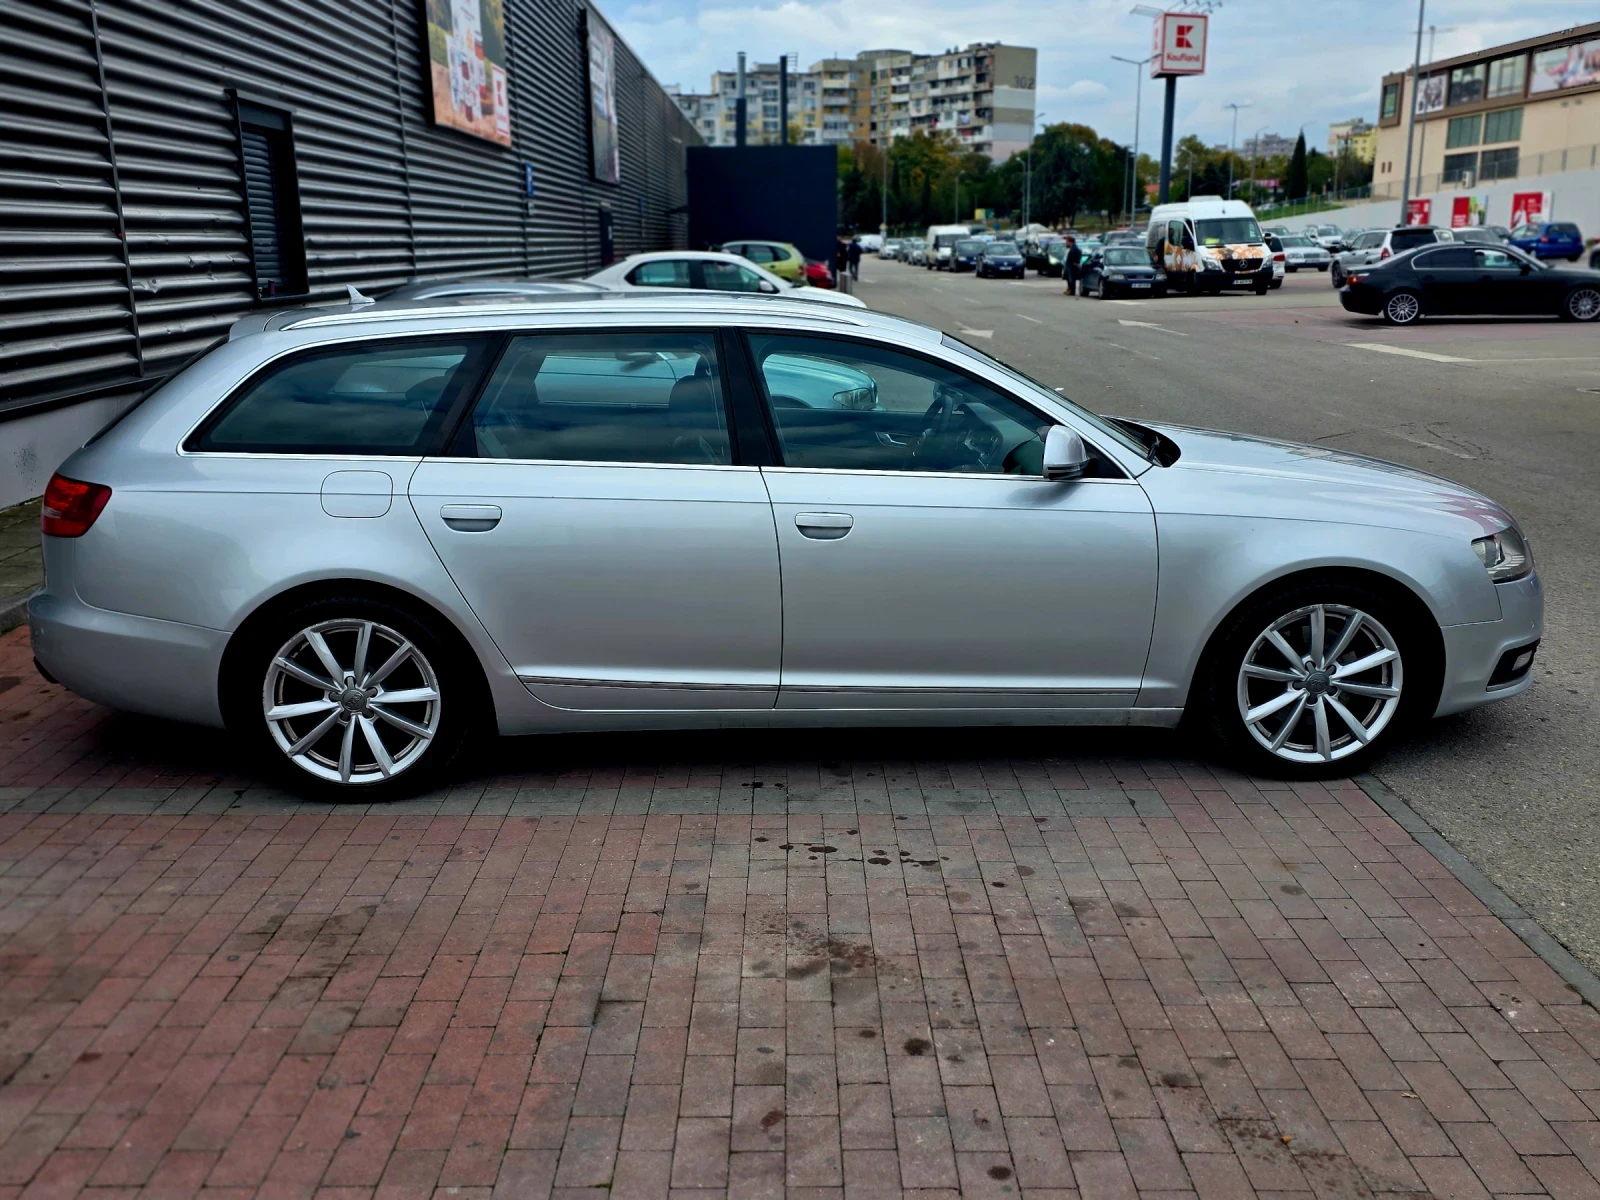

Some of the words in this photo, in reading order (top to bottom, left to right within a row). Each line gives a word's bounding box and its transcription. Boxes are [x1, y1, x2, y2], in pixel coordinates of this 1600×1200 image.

[1176, 24, 1194, 48] K
[1167, 52, 1200, 62] Kaufland
[1014, 75, 1035, 90] 302
